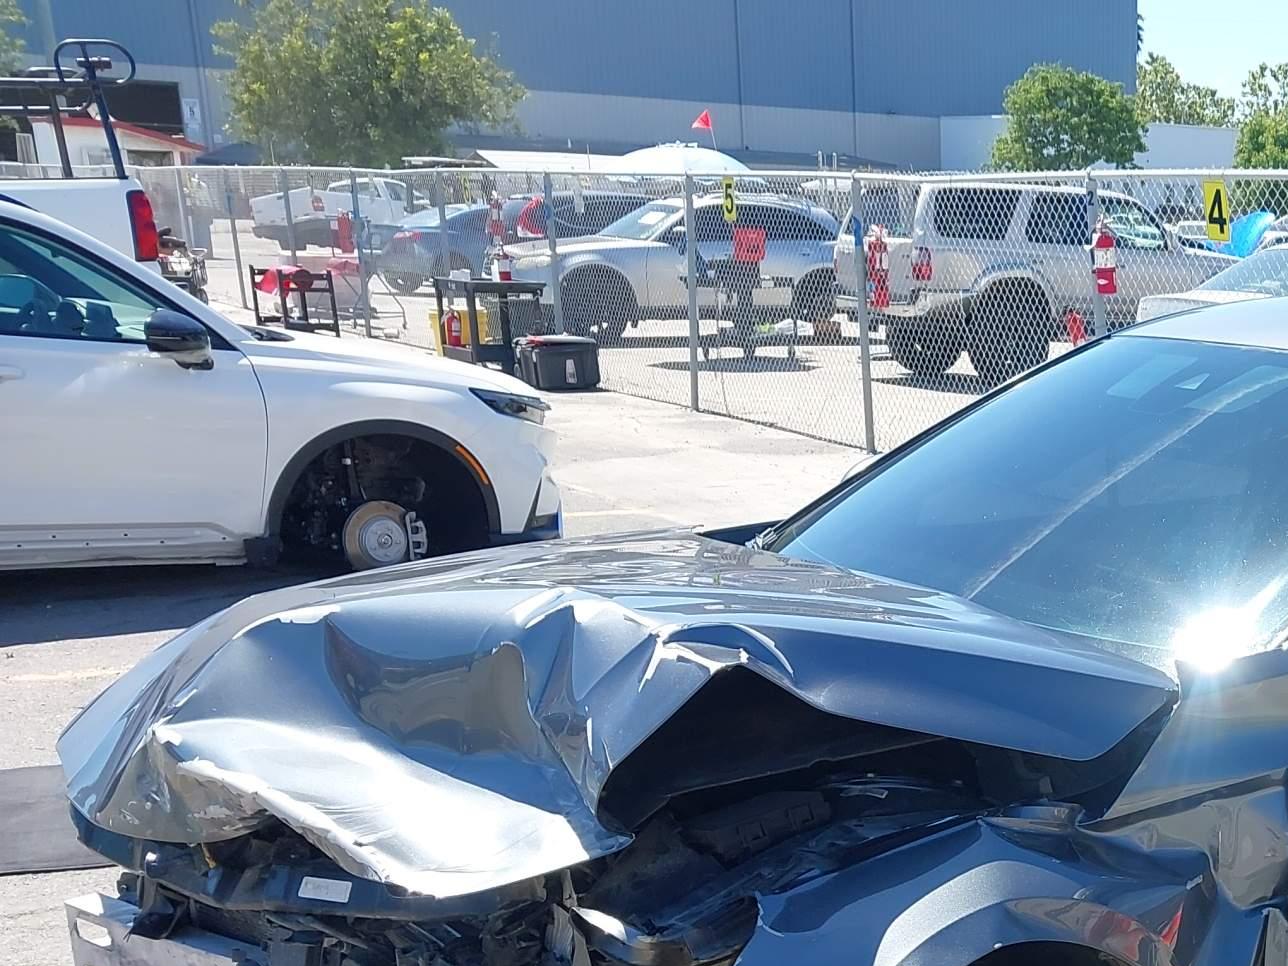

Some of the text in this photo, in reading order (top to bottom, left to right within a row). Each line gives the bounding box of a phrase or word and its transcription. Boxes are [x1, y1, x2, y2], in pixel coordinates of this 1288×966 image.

[725, 183, 733, 214] 5
[1087, 190, 1095, 206] 2
[1208, 188, 1227, 234] 4
